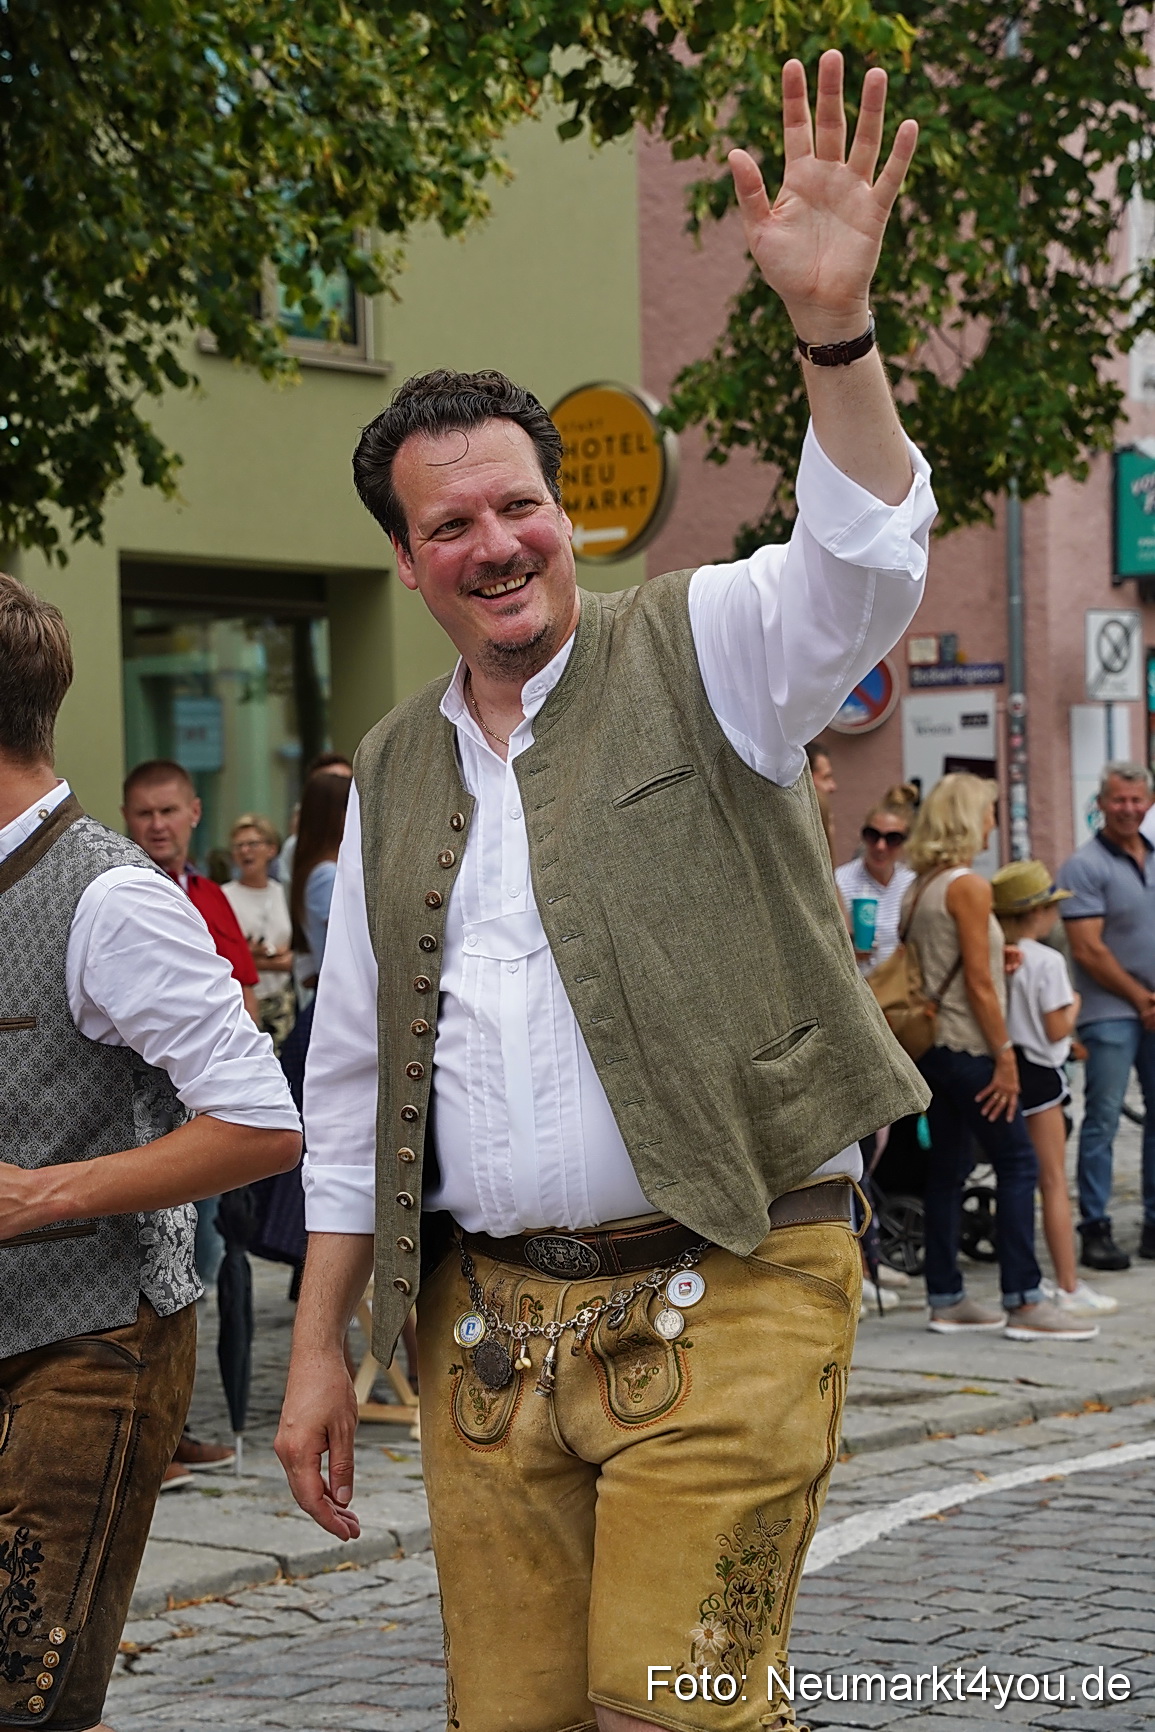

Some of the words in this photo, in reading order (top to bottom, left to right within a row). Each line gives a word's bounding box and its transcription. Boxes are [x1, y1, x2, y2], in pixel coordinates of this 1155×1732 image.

[563, 432, 648, 460] HOTEL
[563, 462, 616, 487] NEU
[563, 486, 648, 512] MARKT
